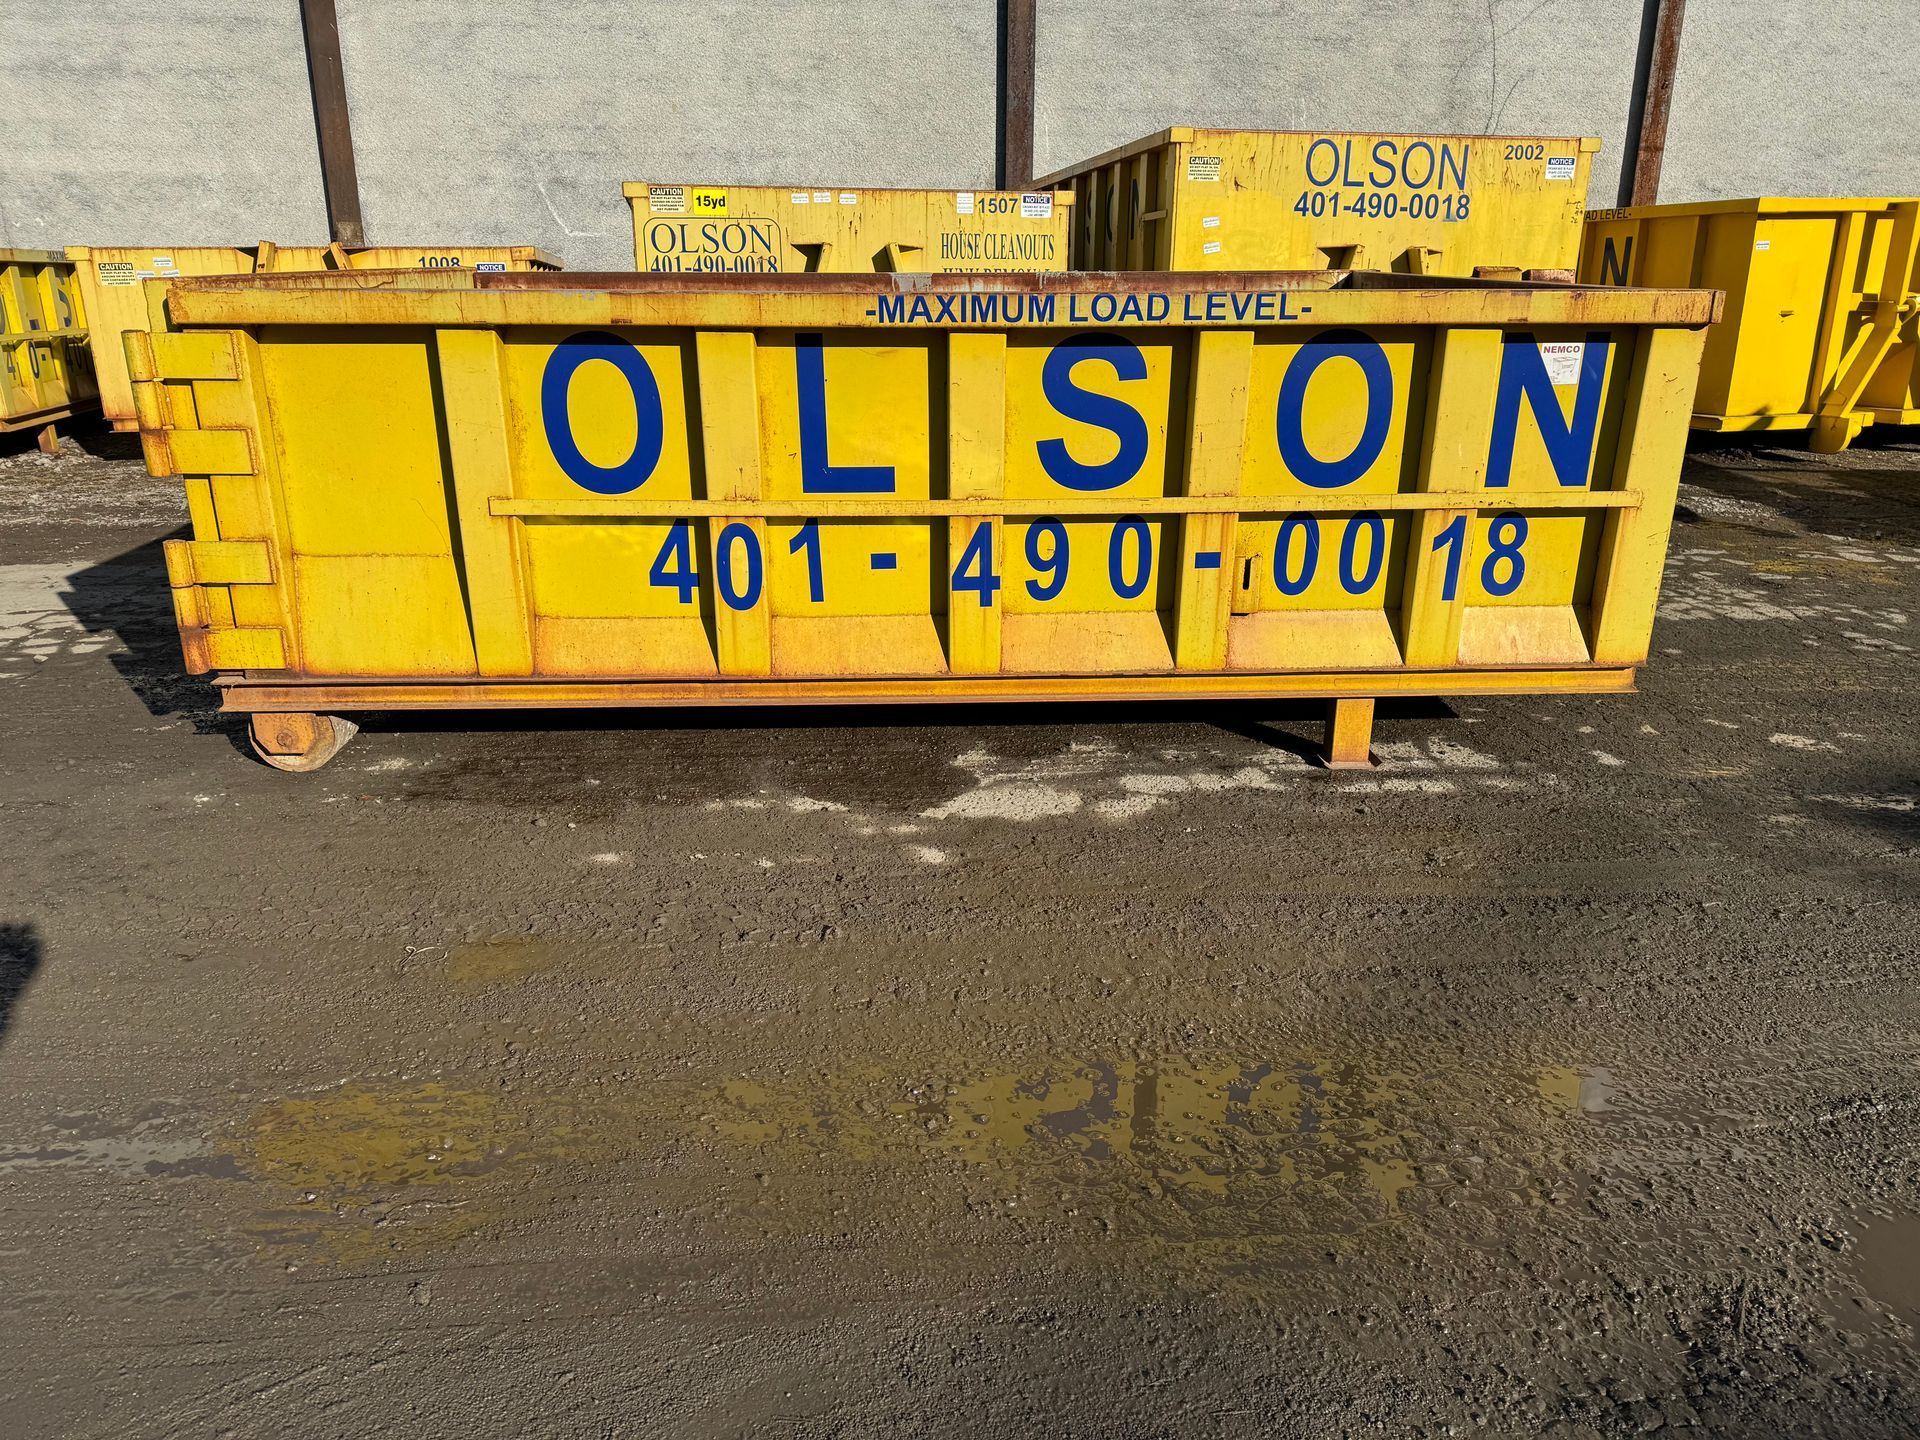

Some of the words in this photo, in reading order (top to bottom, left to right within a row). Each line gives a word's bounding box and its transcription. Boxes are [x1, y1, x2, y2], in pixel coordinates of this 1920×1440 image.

[1306, 138, 1469, 190] OLSON
[1504, 144, 1544, 160] 2002
[696, 195, 725, 209] 15yd
[978, 197, 1018, 213] 1507
[1293, 191, 1470, 220] 401-490-0018
[651, 223, 773, 254] OLSON
[941, 232, 981, 260] HOUSE
[984, 233, 1055, 260] CLEANOUTS
[419, 256, 460, 268] 1008
[651, 255, 778, 272] 401-490-0018
[865, 293, 1055, 323] -MAXIMUM
[1068, 292, 1171, 322] LOAD
[1183, 292, 1312, 321] LEVEL-
[1543, 345, 1580, 354] NEMCO
[541, 328, 1612, 495] OLSON
[649, 510, 1528, 611] 401-490-0018
